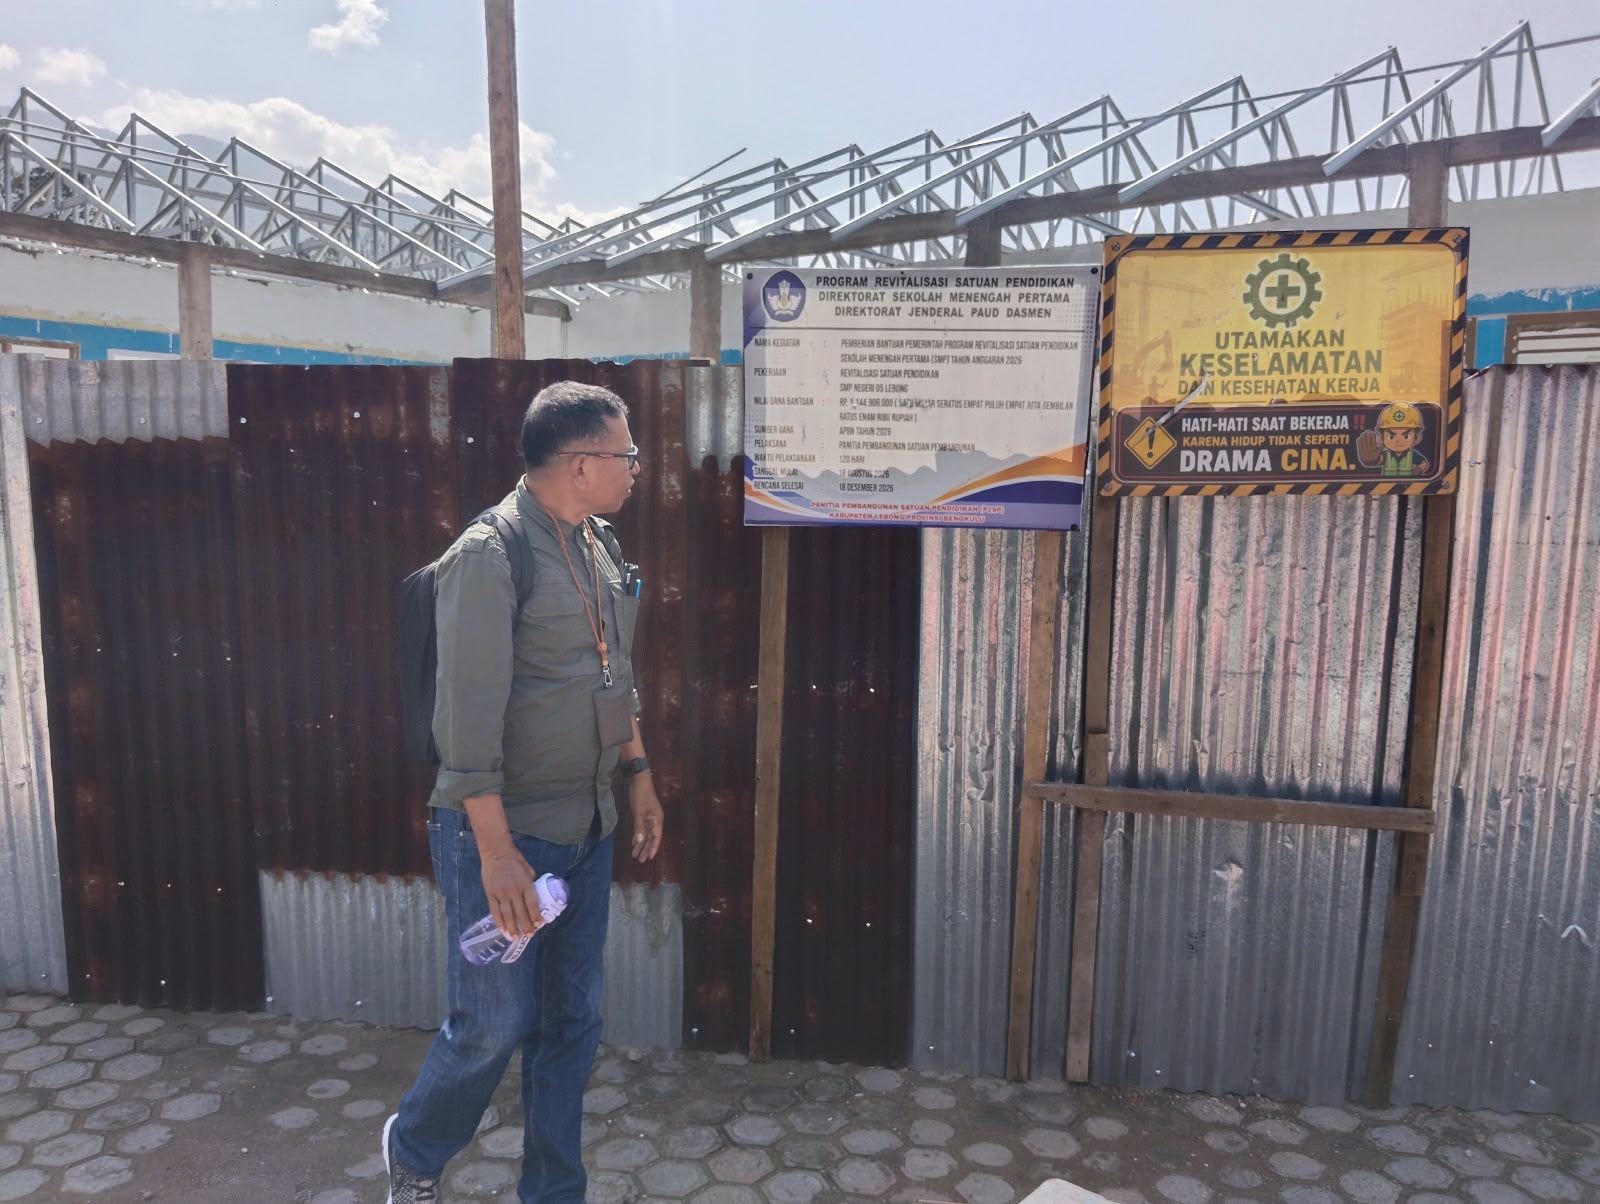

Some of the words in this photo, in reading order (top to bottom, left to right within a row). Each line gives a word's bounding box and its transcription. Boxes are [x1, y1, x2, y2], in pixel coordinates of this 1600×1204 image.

[816, 276, 868, 287] PROGRAM
[875, 276, 948, 288] REVITALISASI
[955, 277, 999, 288] SATUAN
[1006, 277, 1075, 288] PENDIDIKAN
[819, 291, 886, 302] DIREKTORAT
[893, 292, 942, 303] SEKOLAH
[950, 292, 1011, 303] MENENGAH
[1018, 293, 1070, 304] PERTAMA
[835, 307, 902, 317] DIREKTORAT
[908, 307, 964, 318] JENDERAL
[971, 308, 1000, 318] PAUD
[1006, 308, 1052, 319] DASMEN
[754, 338, 772, 348] NAMA
[773, 338, 801, 348] KEGIATAN
[841, 339, 876, 349] PEMBERIAN
[876, 339, 904, 349] BANTUAN
[905, 340, 943, 350] PEMERINTAH
[944, 340, 974, 350] PROGRAM
[975, 340, 1015, 350] REVITALISASI
[1016, 341, 1040, 351] SATUAN
[1041, 341, 1079, 351] PENDIDIKAN
[1214, 329, 1345, 350] UTAMAKAN
[841, 354, 867, 363] SEKOLAH
[868, 354, 901, 364] MENENGAH
[902, 354, 930, 364] PERTAMA
[951, 355, 971, 365] TAHUN
[971, 355, 1005, 365] ANGGARAN
[1006, 356, 1023, 366] 2026
[1179, 349, 1383, 377] KESELAMATAN
[754, 368, 787, 377] PEKERJAAN
[840, 369, 879, 379] REVITALISASI
[879, 369, 903, 379] SATUAN
[903, 370, 940, 379] PENDIDIKAN
[840, 383, 853, 393] SMP
[854, 384, 875, 393] NEGERI
[876, 384, 884, 393] 05
[885, 384, 909, 393] LEBONG
[1177, 379, 1216, 397] DAN
[1220, 378, 1320, 396] KESEHATAN
[1326, 376, 1381, 394] KERJA
[754, 397, 769, 406] NILAI
[770, 397, 786, 406] DANA
[787, 397, 814, 406] BANTUAN
[850, 398, 894, 408] 1144.906.000
[936, 399, 963, 409] SERATUS
[964, 400, 984, 409] EMPAT
[985, 400, 1005, 409] PULUH
[1005, 400, 1025, 410] EMPAT
[1026, 401, 1041, 410] JUTA
[1042, 401, 1074, 411] SEMBILAN
[839, 412, 858, 422] RATUS
[859, 413, 876, 422] ENAM
[877, 413, 891, 422] RIBU
[892, 413, 914, 423] RUPIAH
[754, 425, 779, 434] SUMBER
[779, 426, 794, 434] DANA
[1181, 416, 1249, 433] HATI-HATI
[1252, 416, 1287, 432] SAAT
[1290, 415, 1350, 432] BEKERJA
[839, 426, 855, 436] APBN
[856, 427, 875, 436] TAHUN
[876, 427, 892, 437] 2026
[755, 439, 787, 448] PELAKSANA
[839, 441, 861, 450] PANITIA
[862, 442, 907, 451] PEMBANGUNAN
[907, 443, 930, 452] SATUAN
[1183, 436, 1228, 448] KARENA
[1231, 436, 1265, 447] HIDUP
[1268, 435, 1302, 447] TIDAK
[1305, 434, 1350, 446] SEPERTI
[776, 454, 816, 463] PELAKSANAAN
[839, 455, 851, 464] 120
[851, 456, 865, 464] HARI
[1180, 449, 1273, 473] DRAMA
[1281, 448, 1356, 472] CINA.
[753, 481, 781, 490] RENCANA
[781, 481, 804, 490] SELESAI
[839, 483, 846, 492] 18
[847, 483, 878, 492] DESEMBER
[879, 484, 894, 493] 2026
[932, 505, 978, 513] PENDIDIKAN
